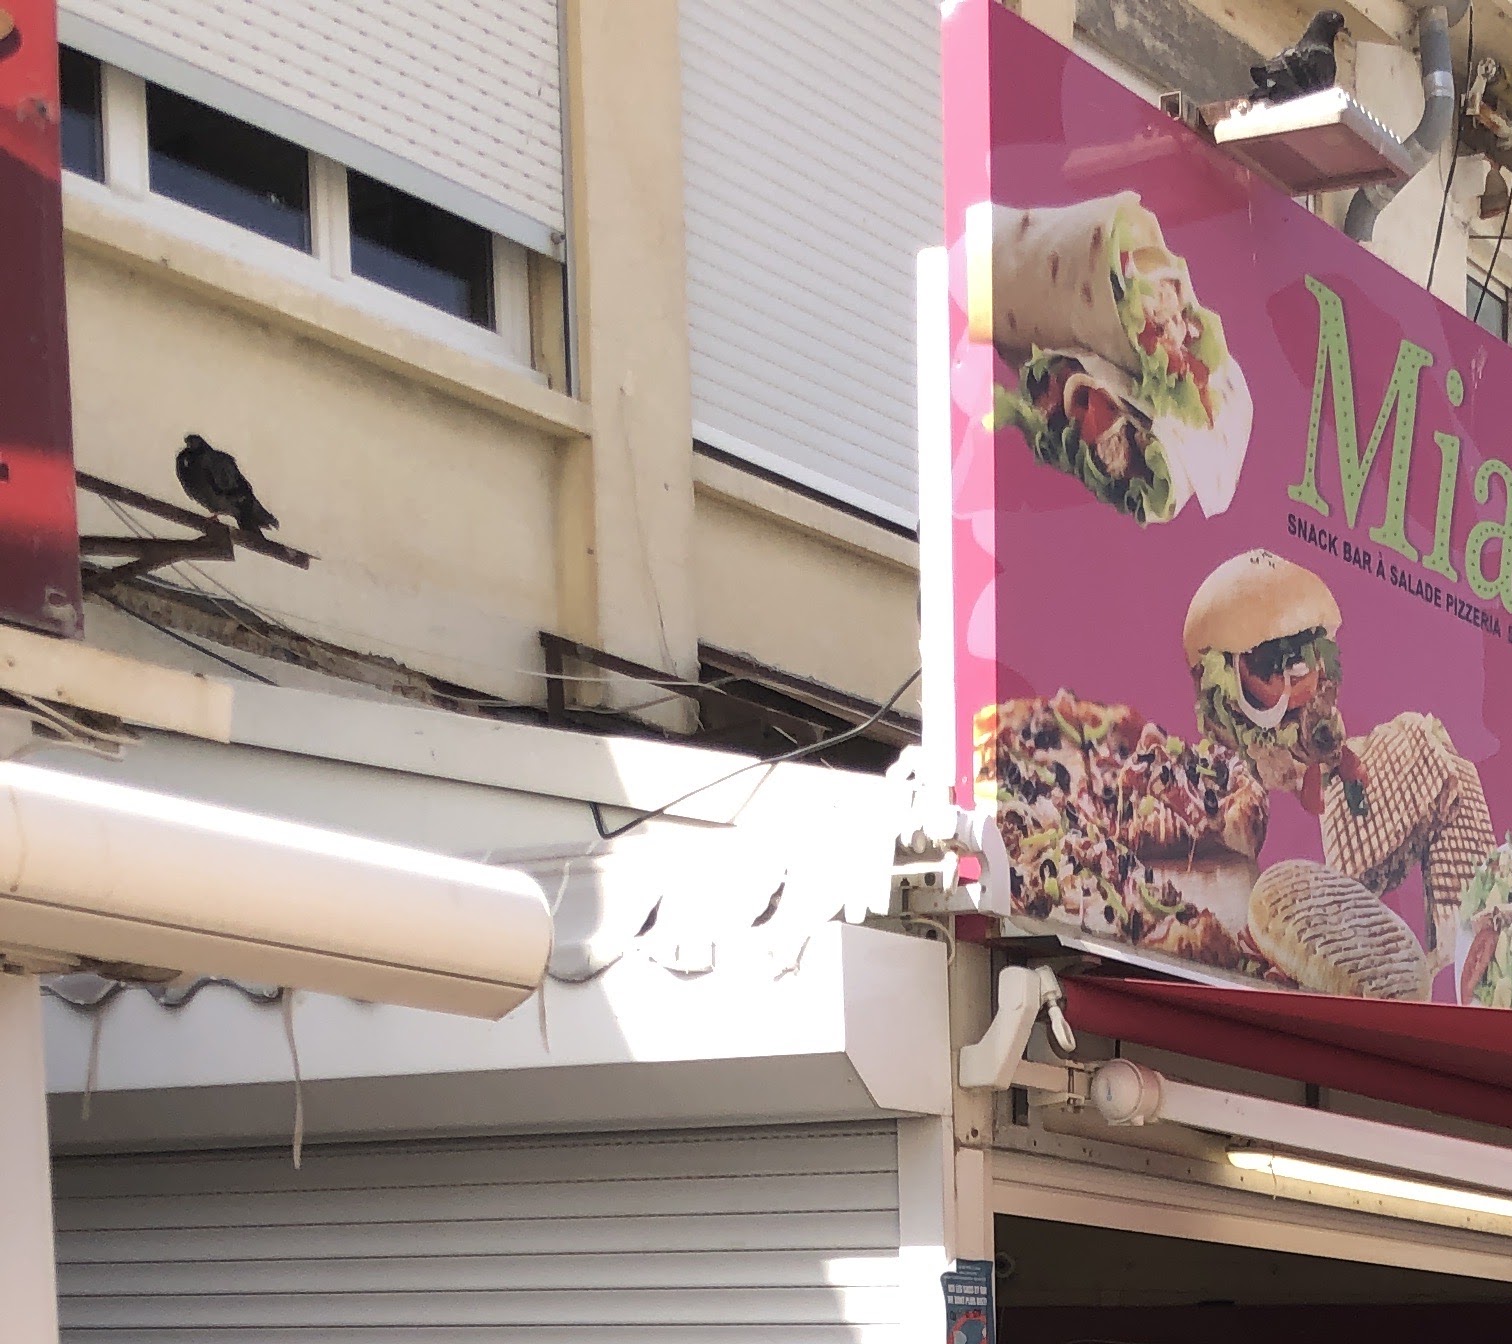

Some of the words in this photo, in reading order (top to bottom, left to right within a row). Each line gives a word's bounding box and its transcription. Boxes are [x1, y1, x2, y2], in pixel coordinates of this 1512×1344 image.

[1287, 513, 1340, 557] SNACK
[1342, 540, 1373, 575] BAR
[1376, 553, 1388, 582] À
[1390, 565, 1443, 609] SALADE
[1445, 592, 1502, 638] PIZZERIA
